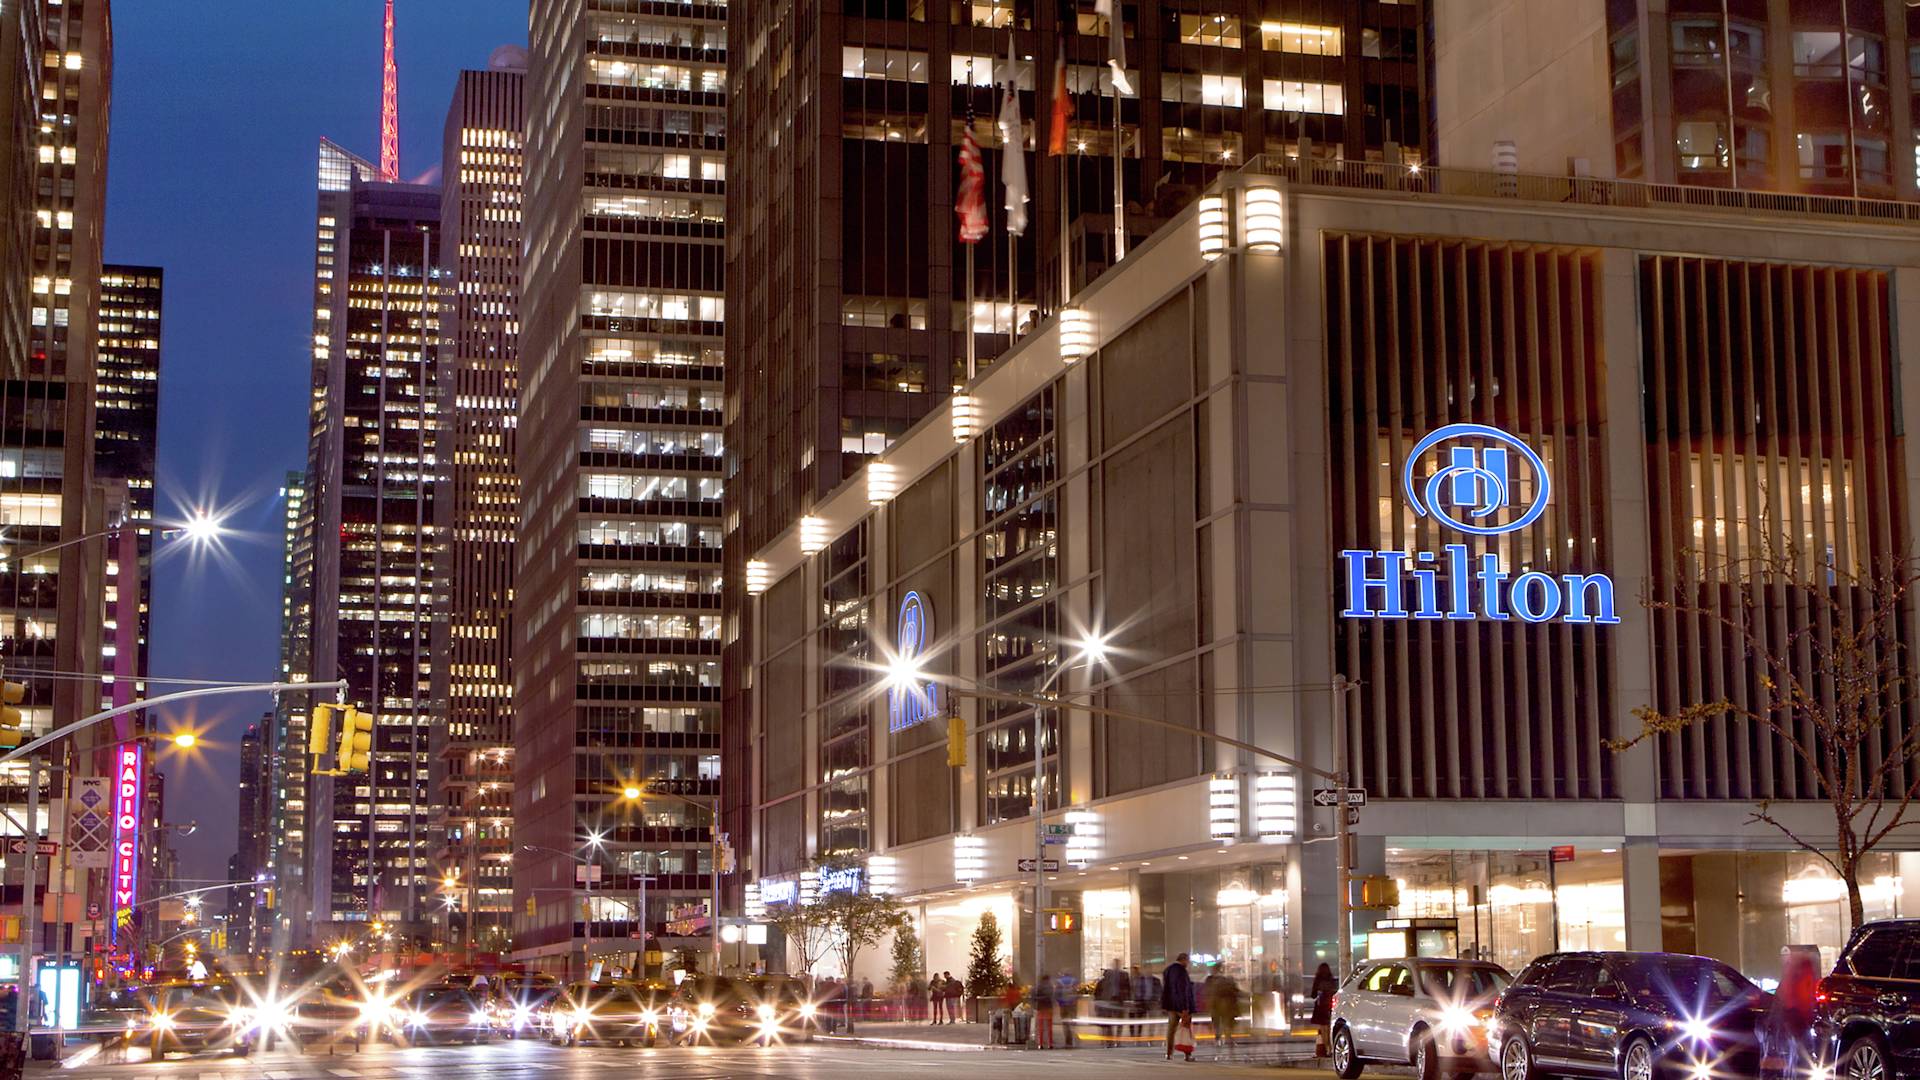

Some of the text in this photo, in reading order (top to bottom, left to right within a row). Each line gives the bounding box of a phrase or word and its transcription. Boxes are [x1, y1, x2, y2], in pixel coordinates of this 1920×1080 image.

[1343, 544, 1621, 624] Hilton
[120, 751, 136, 830] RADIO
[1320, 794, 1337, 802] ONE
[117, 842, 133, 905] CITY
